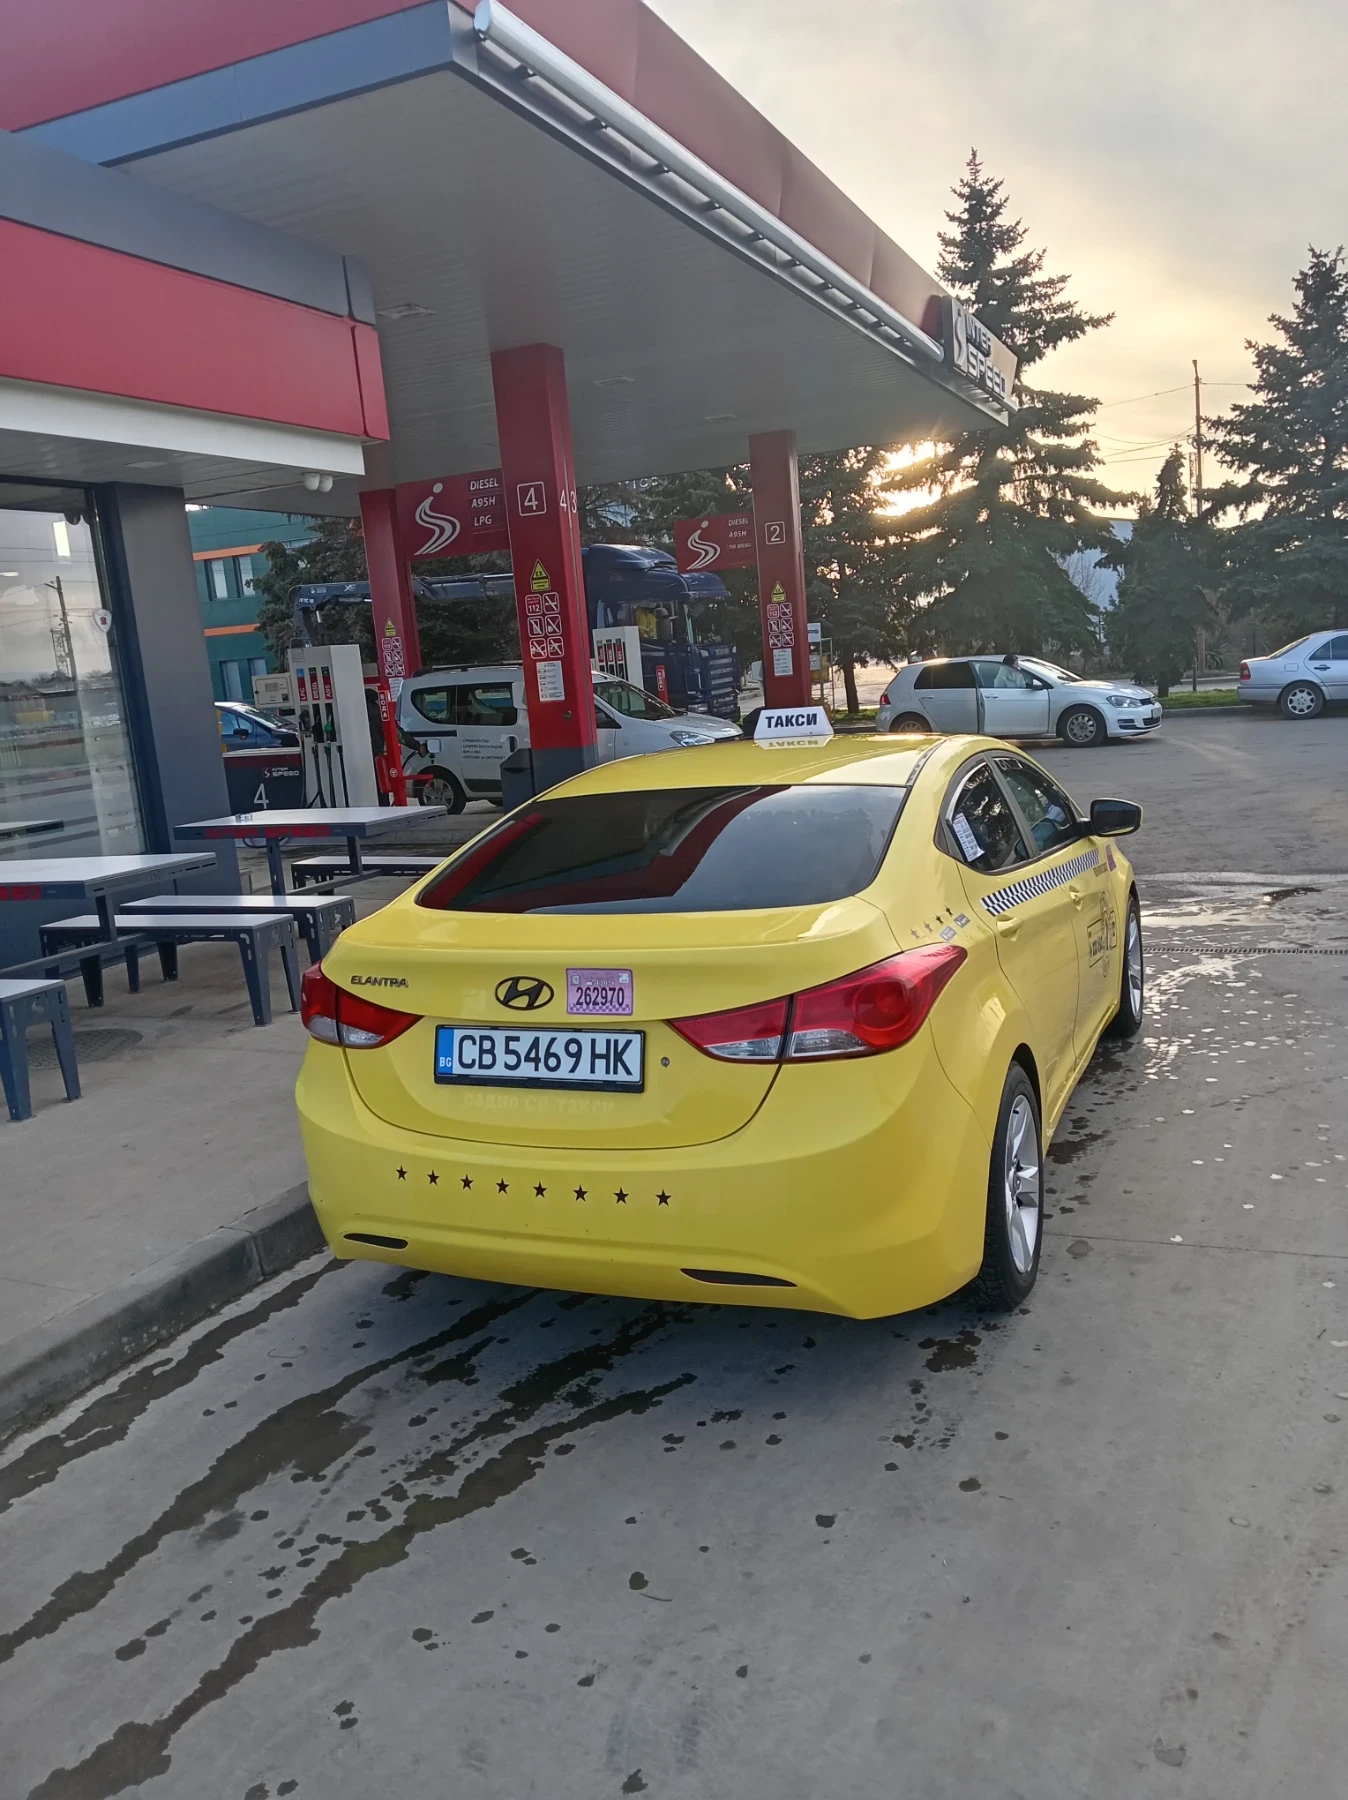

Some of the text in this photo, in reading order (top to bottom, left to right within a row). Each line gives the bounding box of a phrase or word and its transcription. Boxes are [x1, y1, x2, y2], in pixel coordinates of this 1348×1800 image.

[470, 478, 499, 490] DIESEL
[471, 496, 496, 508] A95H
[524, 487, 538, 510] 4
[560, 489, 567, 511] 4
[474, 515, 492, 526] LPG
[728, 518, 749, 526] DIESEL
[729, 530, 747, 538] A95H
[770, 525, 780, 541] 2
[528, 604, 540, 612] 112
[380, 693, 388, 719] ВОДА
[765, 713, 817, 728] ТАКСИ
[253, 783, 269, 809] 4
[351, 975, 409, 988] ELANTRA
[575, 987, 625, 1007] 262970
[439, 1056, 452, 1067] BG
[458, 1034, 633, 1076] CB 5469 HK
